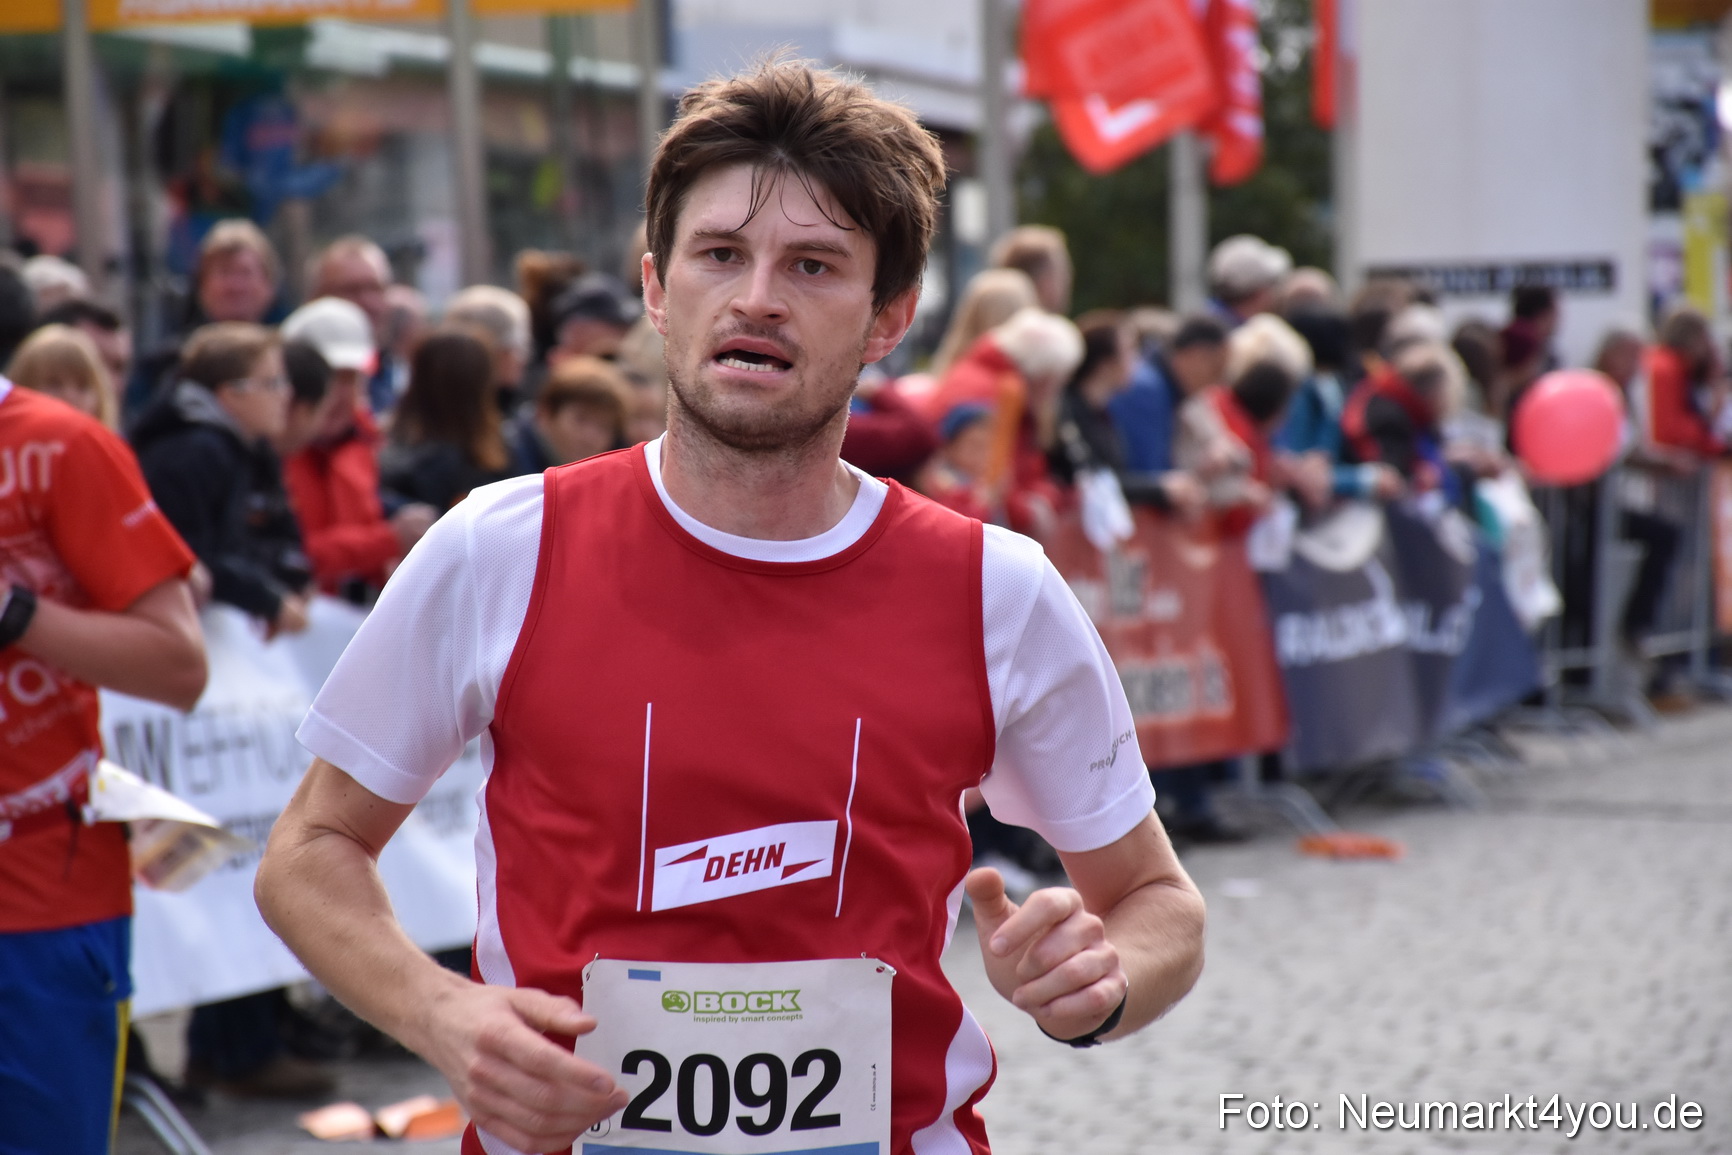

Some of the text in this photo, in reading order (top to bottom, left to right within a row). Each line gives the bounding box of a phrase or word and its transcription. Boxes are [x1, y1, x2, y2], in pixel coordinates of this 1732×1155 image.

[703, 842, 786, 883] DEHN
[694, 990, 801, 1014] BOCK
[693, 1013, 803, 1024] inspired by smart concepts
[620, 1048, 841, 1136] 2092
